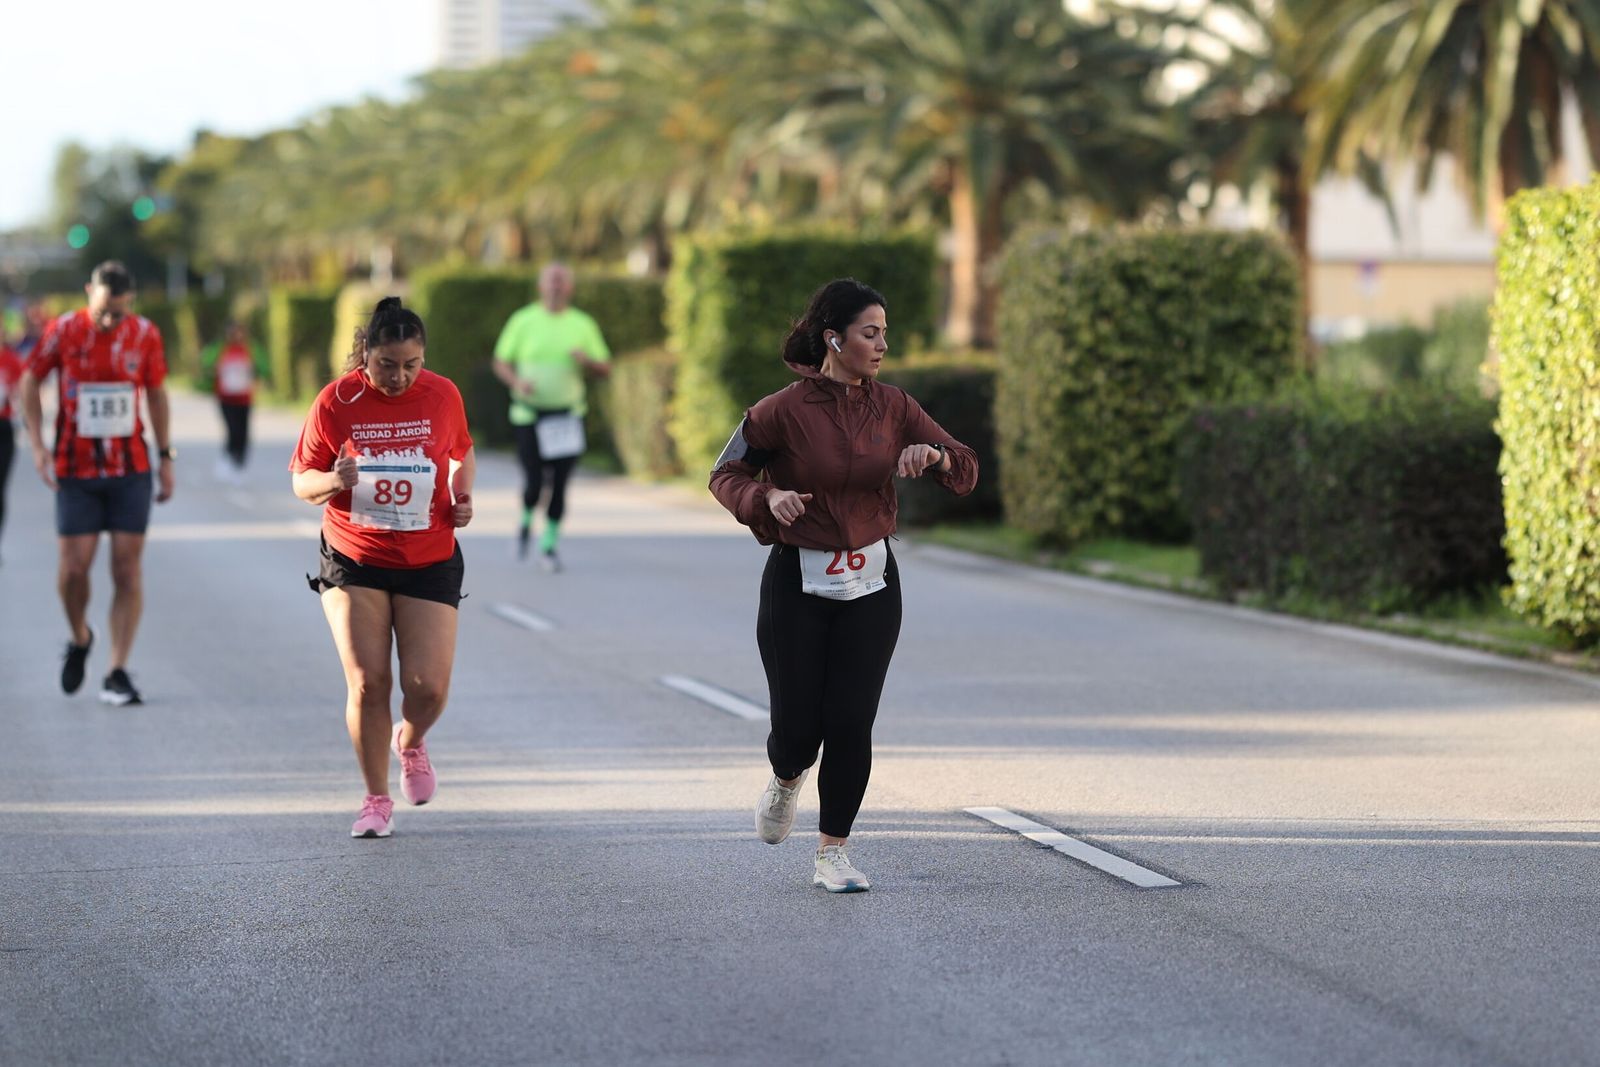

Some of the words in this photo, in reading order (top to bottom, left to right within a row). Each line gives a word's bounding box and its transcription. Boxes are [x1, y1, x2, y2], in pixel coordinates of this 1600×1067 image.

[352, 430, 392, 440] CIUDAD
[394, 425, 431, 438] JARDÍN
[362, 422, 394, 430] CARRERA
[395, 420, 421, 428] URBANA
[374, 479, 413, 506] 89
[826, 549, 866, 575] 26
